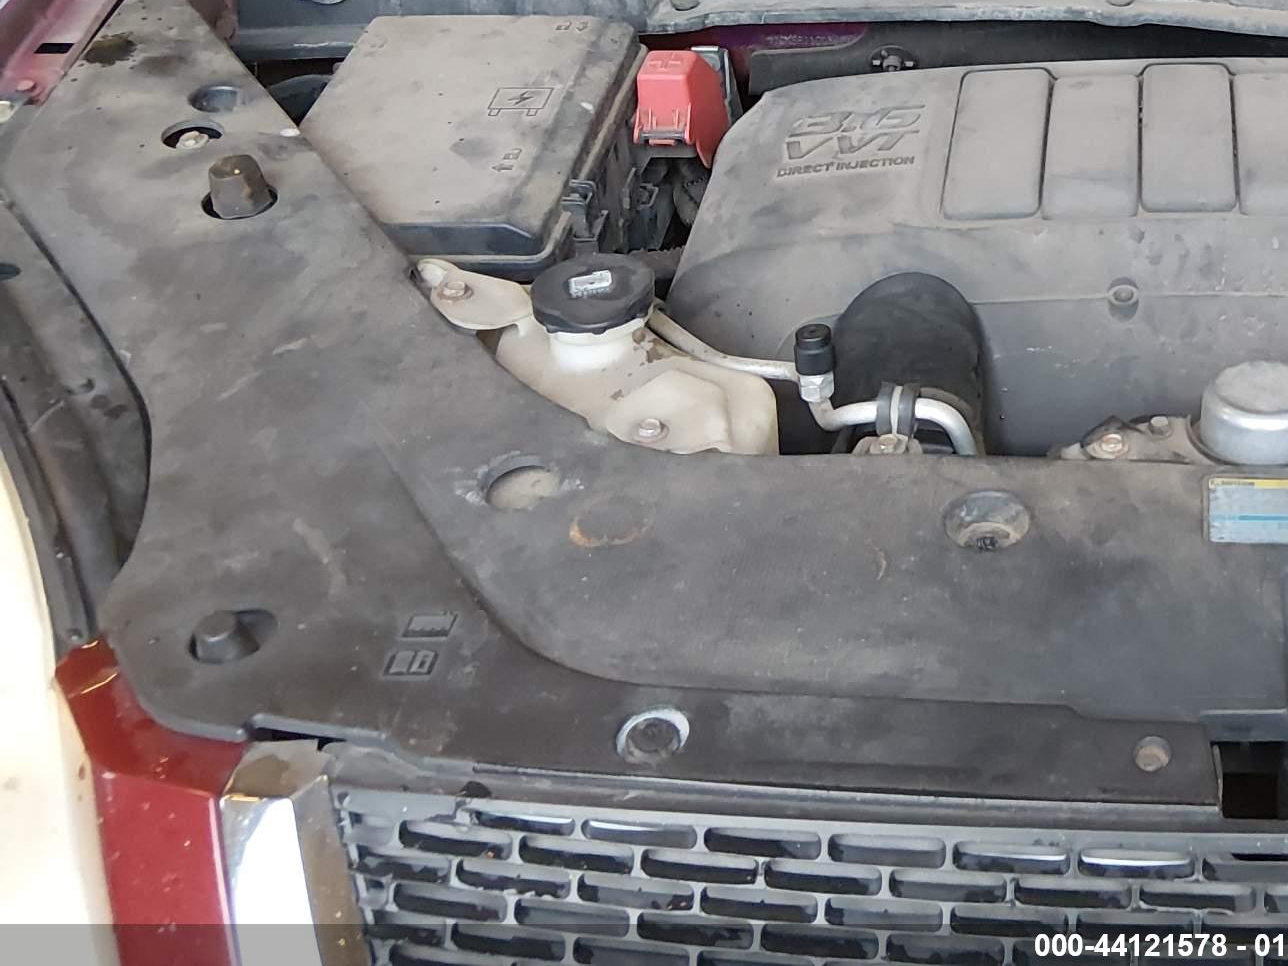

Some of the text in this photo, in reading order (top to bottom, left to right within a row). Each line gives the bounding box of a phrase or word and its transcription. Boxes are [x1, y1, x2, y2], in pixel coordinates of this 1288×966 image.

[786, 130, 920, 160] VVT
[776, 156, 915, 178] DIRECT INJECTION
